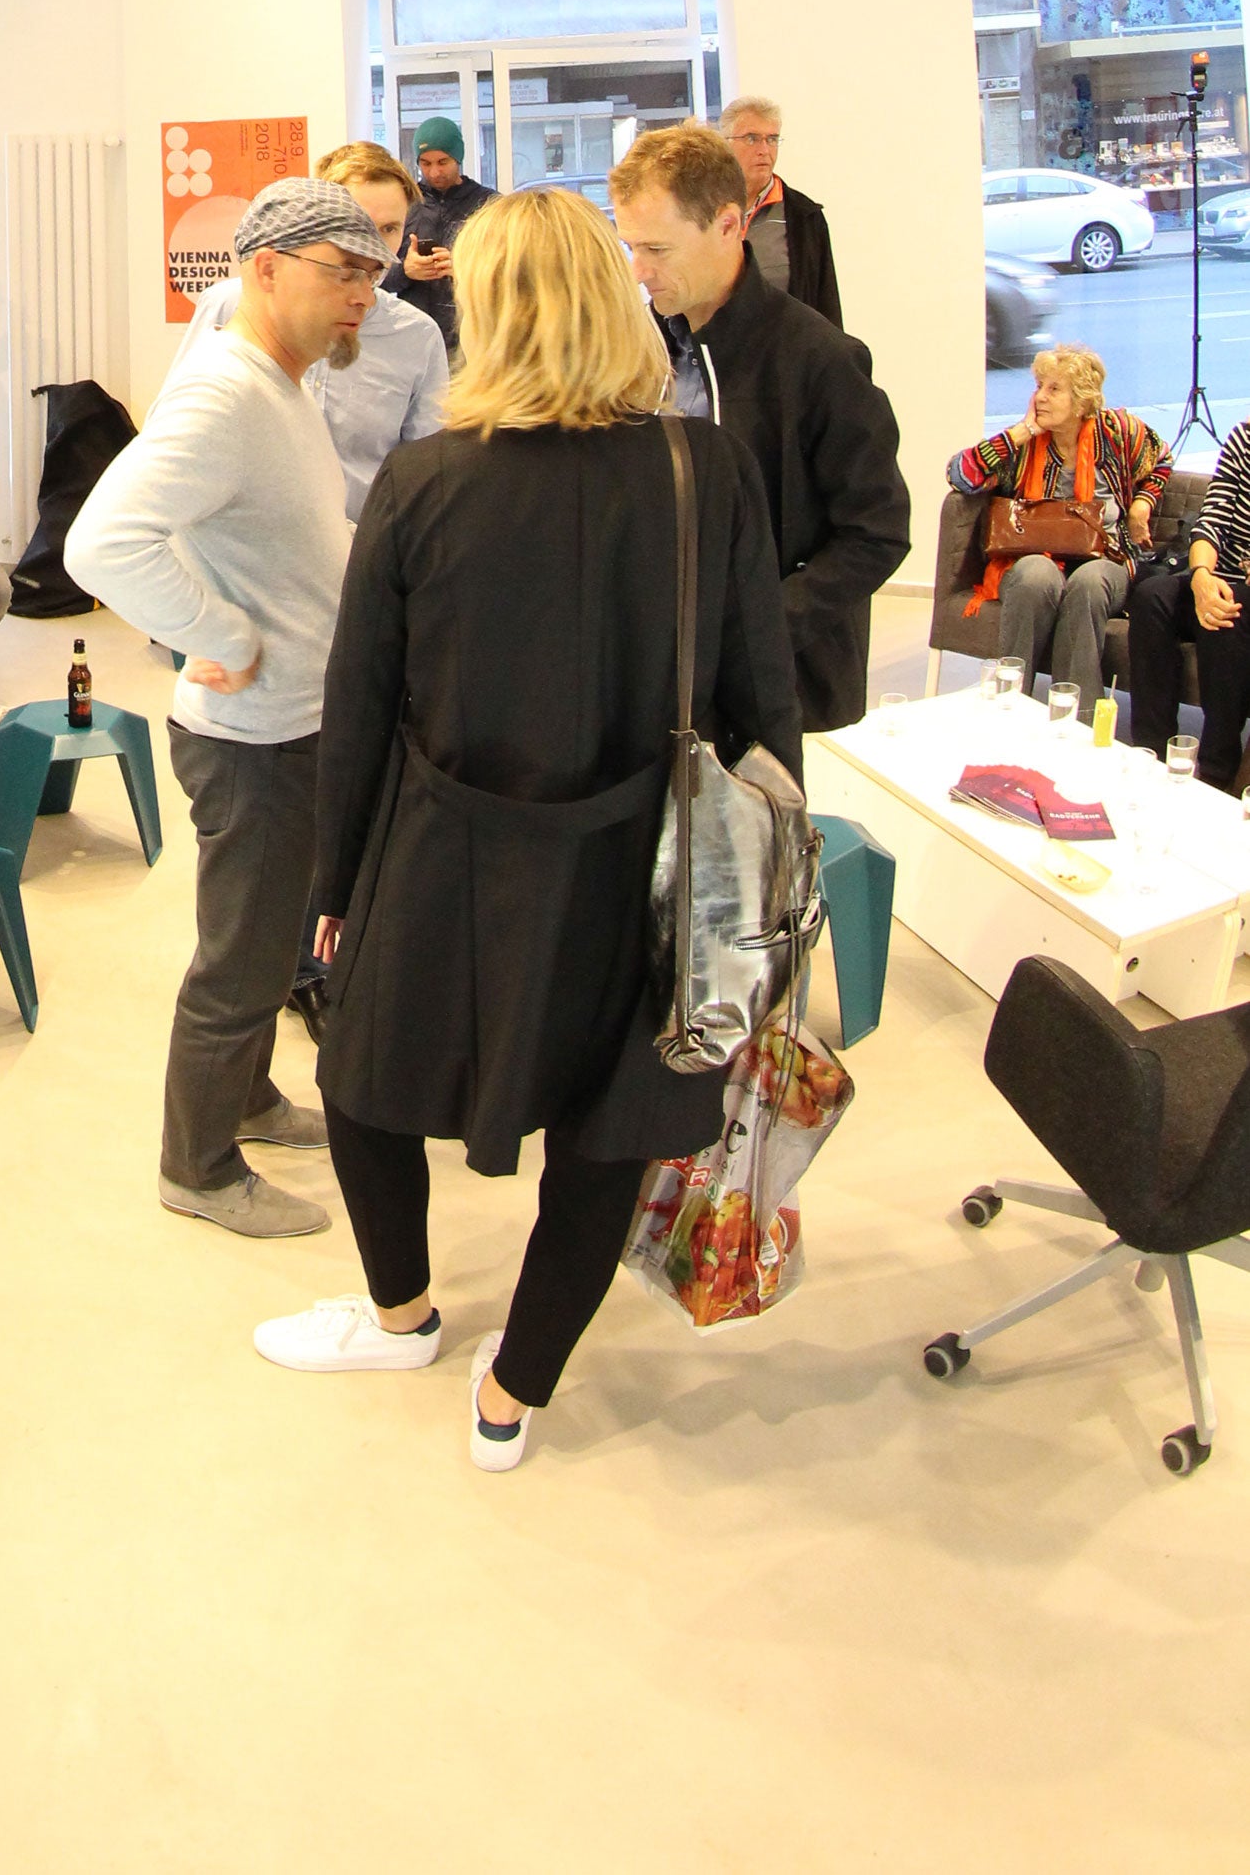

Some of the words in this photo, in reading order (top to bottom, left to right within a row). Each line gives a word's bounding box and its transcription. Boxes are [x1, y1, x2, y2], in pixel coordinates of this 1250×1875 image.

[255, 123, 271, 162] 2018
[169, 251, 232, 263] VIENNA
[169, 266, 230, 278] DESIGN
